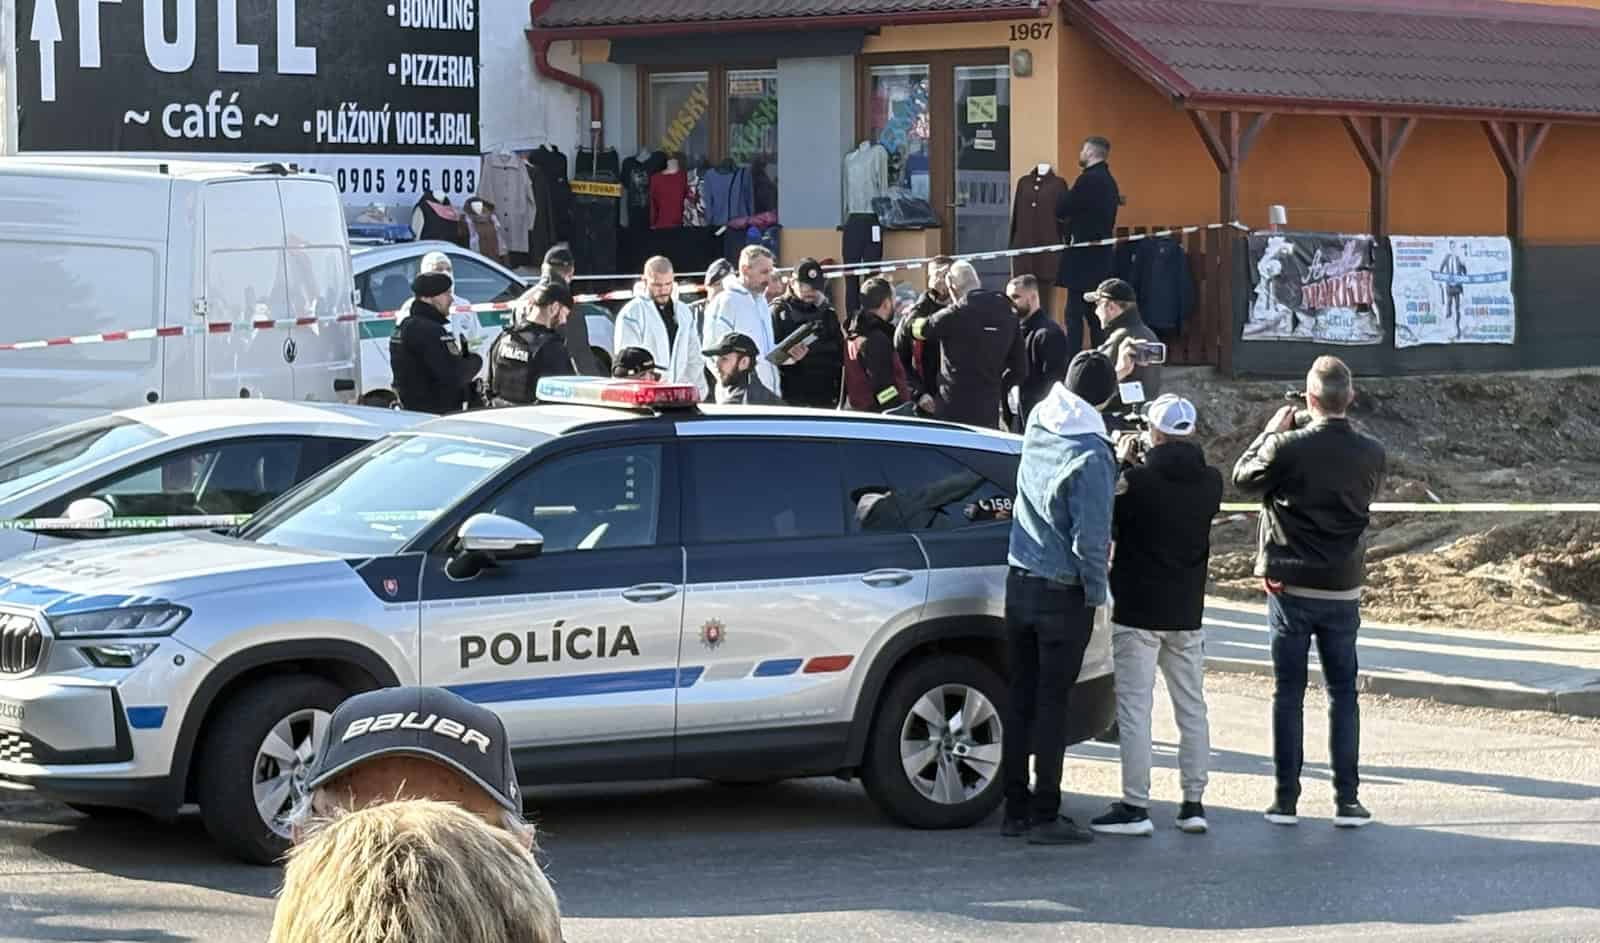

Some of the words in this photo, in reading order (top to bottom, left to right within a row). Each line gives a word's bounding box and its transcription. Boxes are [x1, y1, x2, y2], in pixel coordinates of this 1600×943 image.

[400, 0, 475, 31] BOWLING
[1009, 22, 1054, 42] 1967
[400, 53, 475, 88] PIZZERIA
[161, 90, 243, 139] café
[316, 102, 391, 144] PLÁŽOVÝ
[395, 111, 475, 146] VOLEJBAL
[337, 168, 385, 194] 0905
[396, 168, 432, 193] 296
[442, 168, 476, 194] 083
[990, 498, 1013, 511] 158
[459, 619, 641, 669] POLÍCIA
